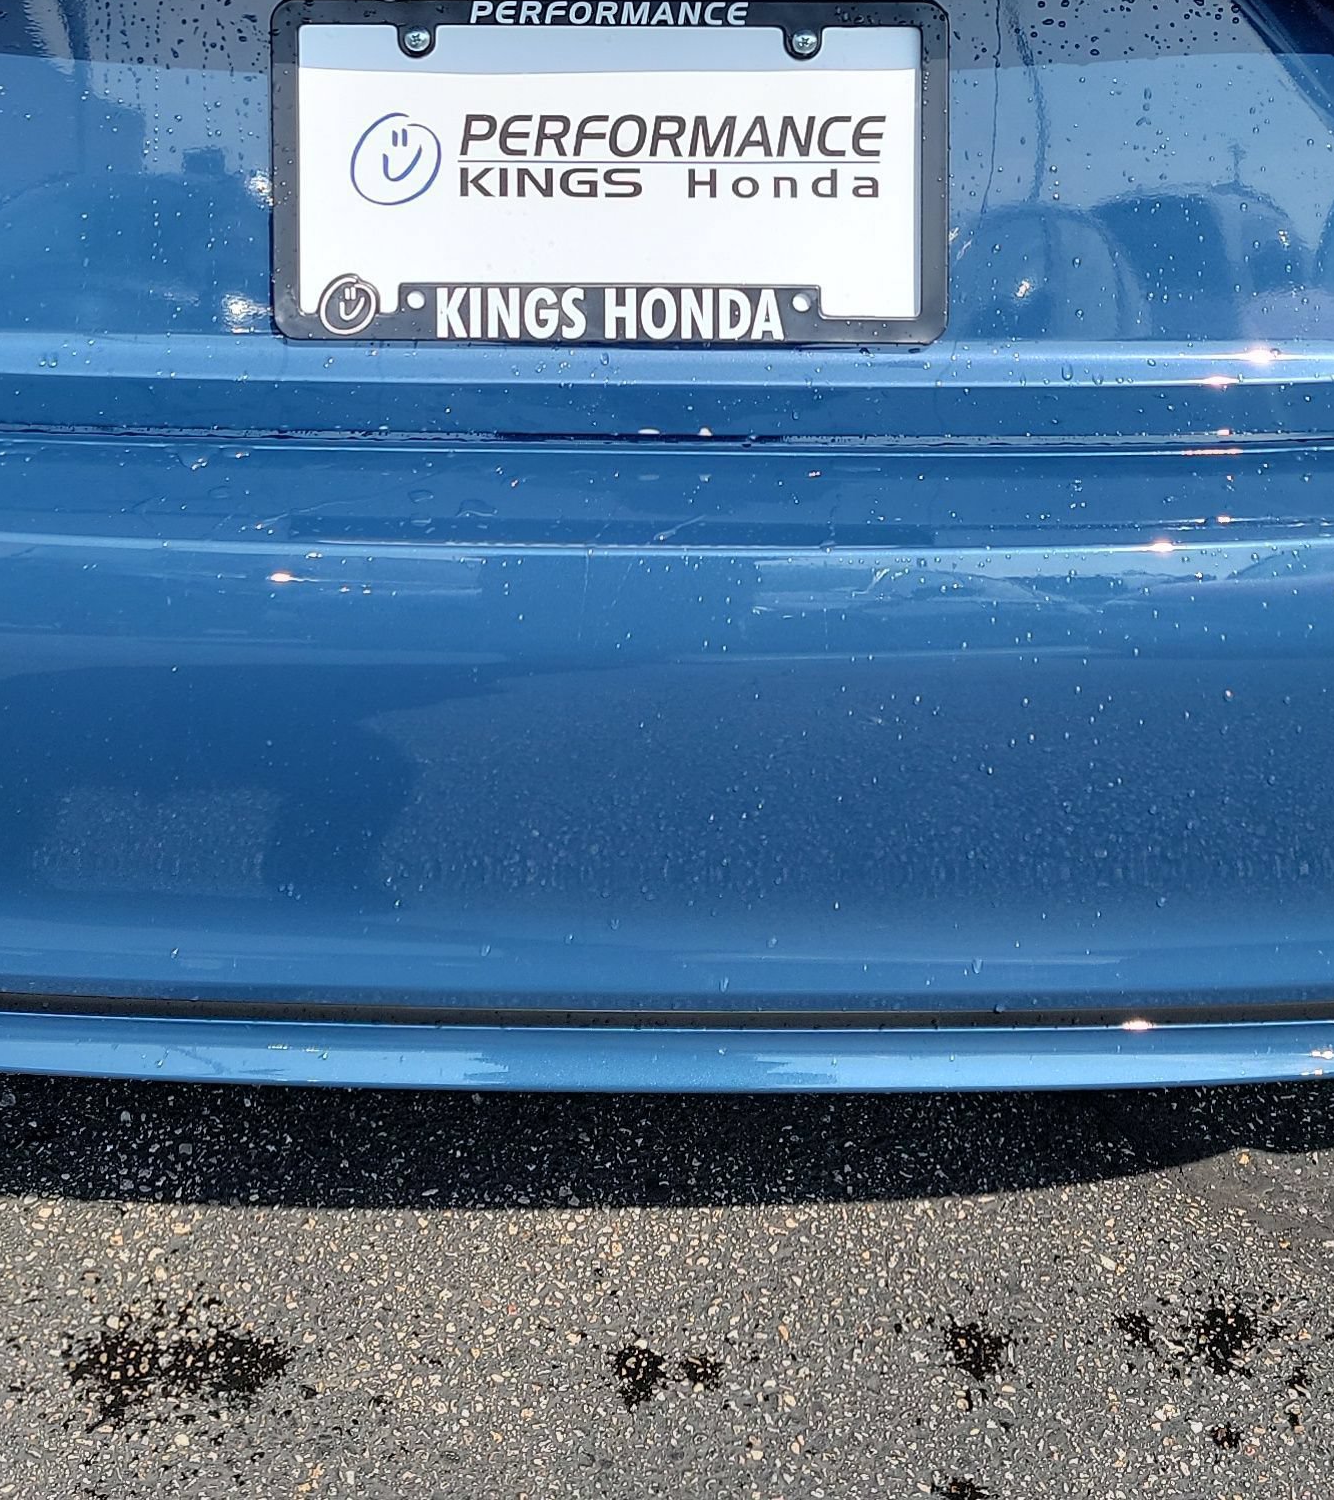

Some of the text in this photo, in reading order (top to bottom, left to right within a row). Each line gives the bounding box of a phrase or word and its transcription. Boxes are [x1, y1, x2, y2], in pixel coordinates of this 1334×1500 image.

[469, 0, 749, 26] PERFORMANCE
[458, 113, 887, 159] PERFORMANCE
[459, 167, 880, 199] KINGS Honda
[435, 287, 785, 341] KINGS HONDA
